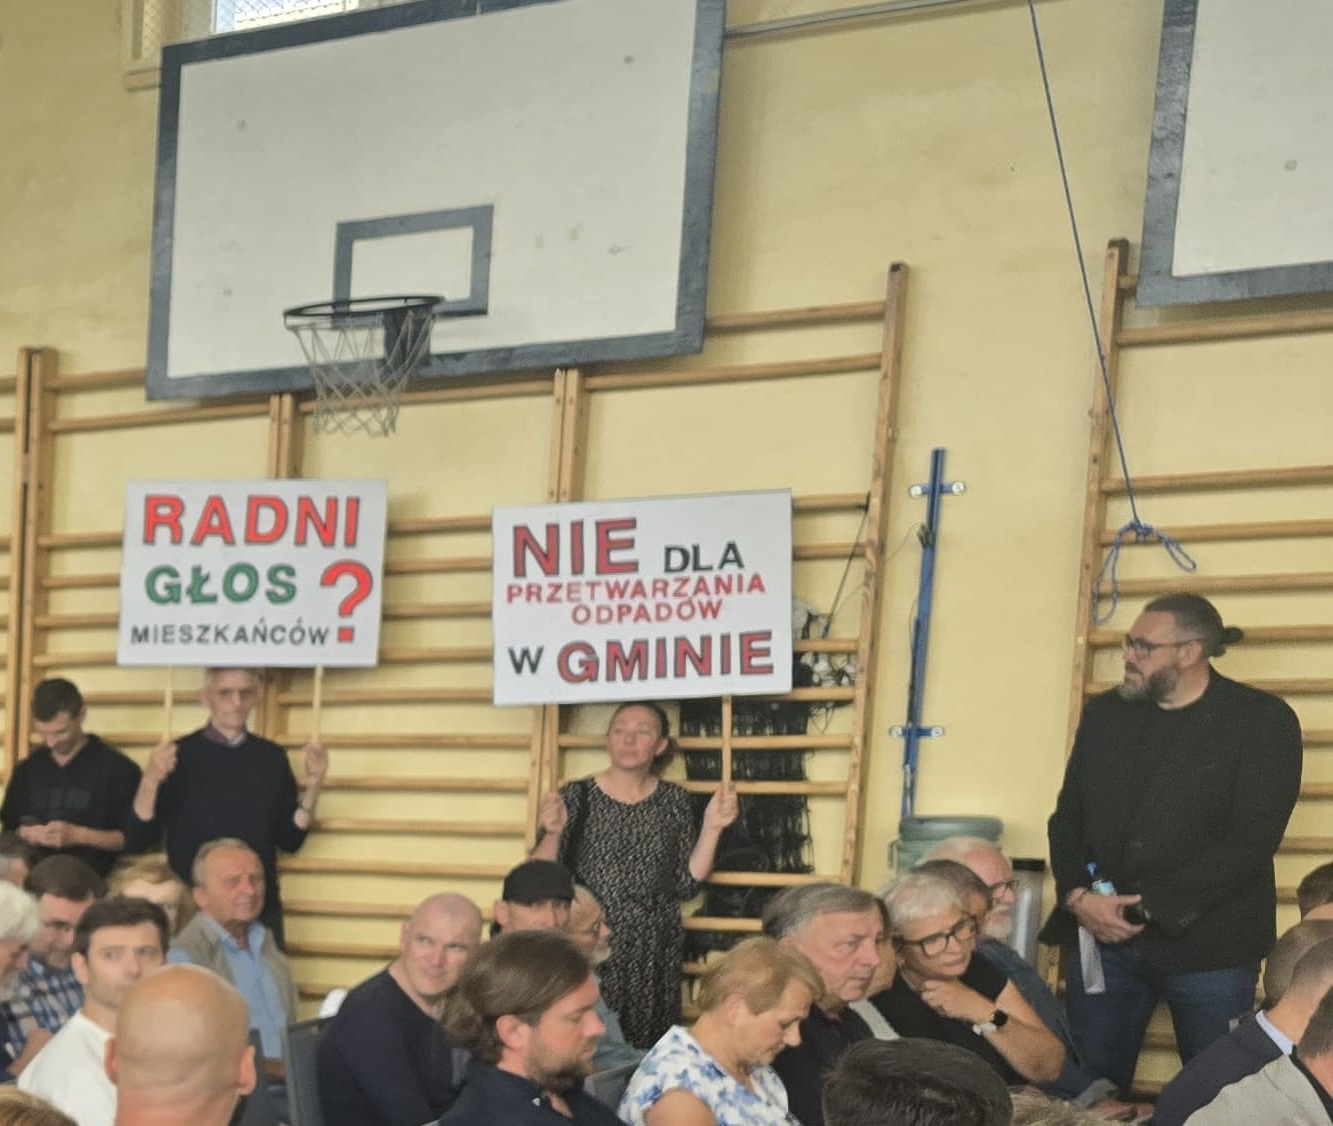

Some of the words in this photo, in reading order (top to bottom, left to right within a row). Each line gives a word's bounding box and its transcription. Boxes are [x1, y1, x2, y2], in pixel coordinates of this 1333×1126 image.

[142, 494, 360, 547] RADNI
[512, 516, 639, 578] NIE
[664, 540, 745, 573] DLA
[144, 561, 297, 605] GŁOS
[505, 572, 766, 604] PRZETWARZANIA
[130, 616, 330, 646] MIESZKAŃCÓW
[571, 595, 724, 626] ODPADÓW
[556, 629, 775, 685] GMINIE
